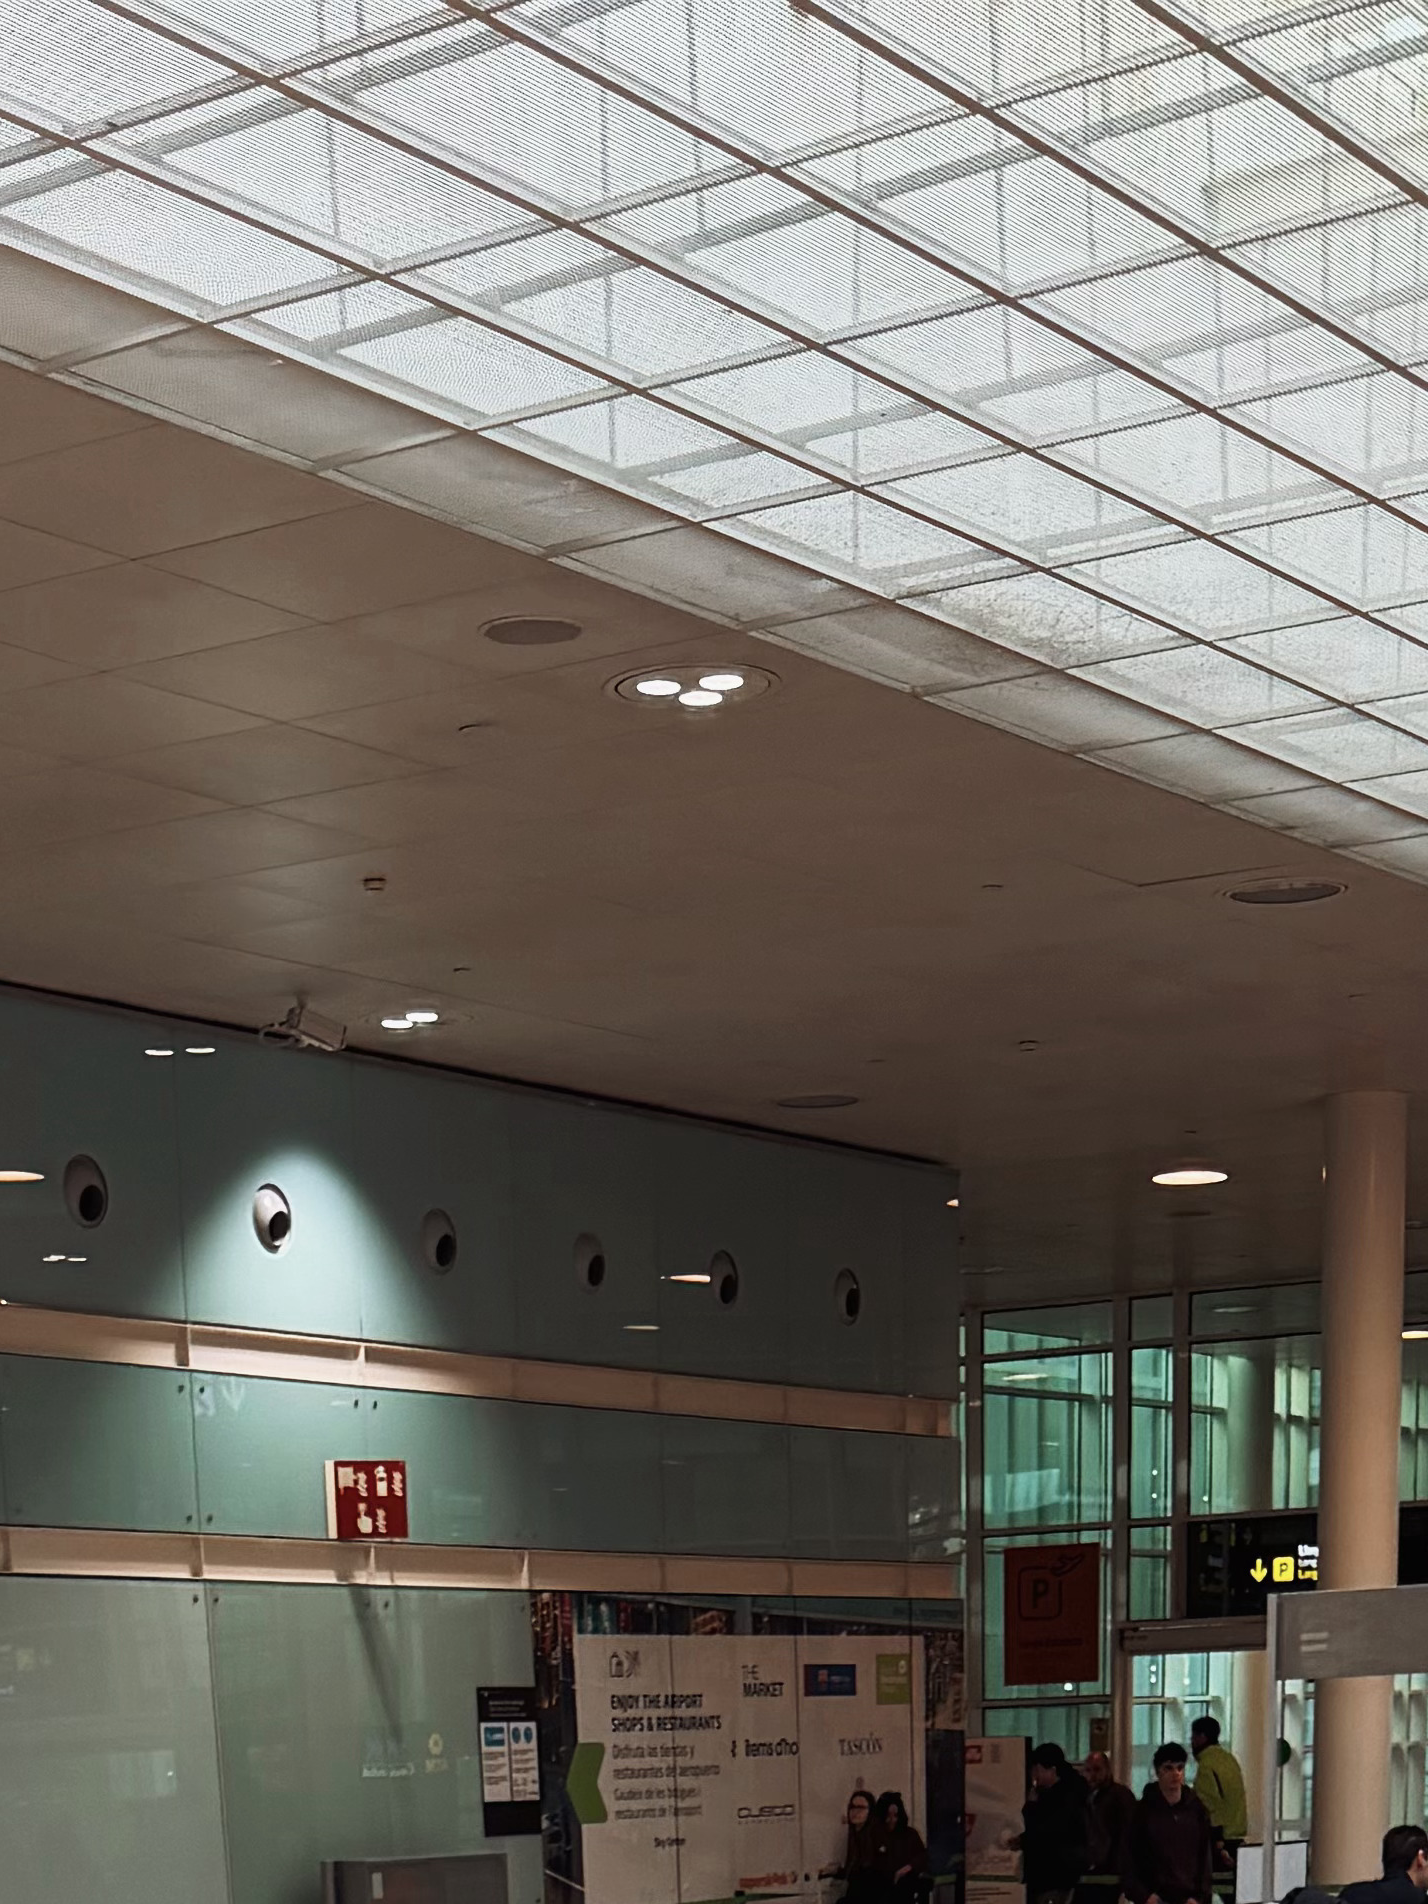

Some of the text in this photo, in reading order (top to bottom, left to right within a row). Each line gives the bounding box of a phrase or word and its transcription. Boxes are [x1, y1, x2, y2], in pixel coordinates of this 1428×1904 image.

[742, 1682, 784, 1698] MARKET
[610, 1693, 703, 1713] ENJOY THE AIRPORT
[611, 1717, 645, 1732] SHOPS
[656, 1715, 721, 1731] RESTAURANTS
